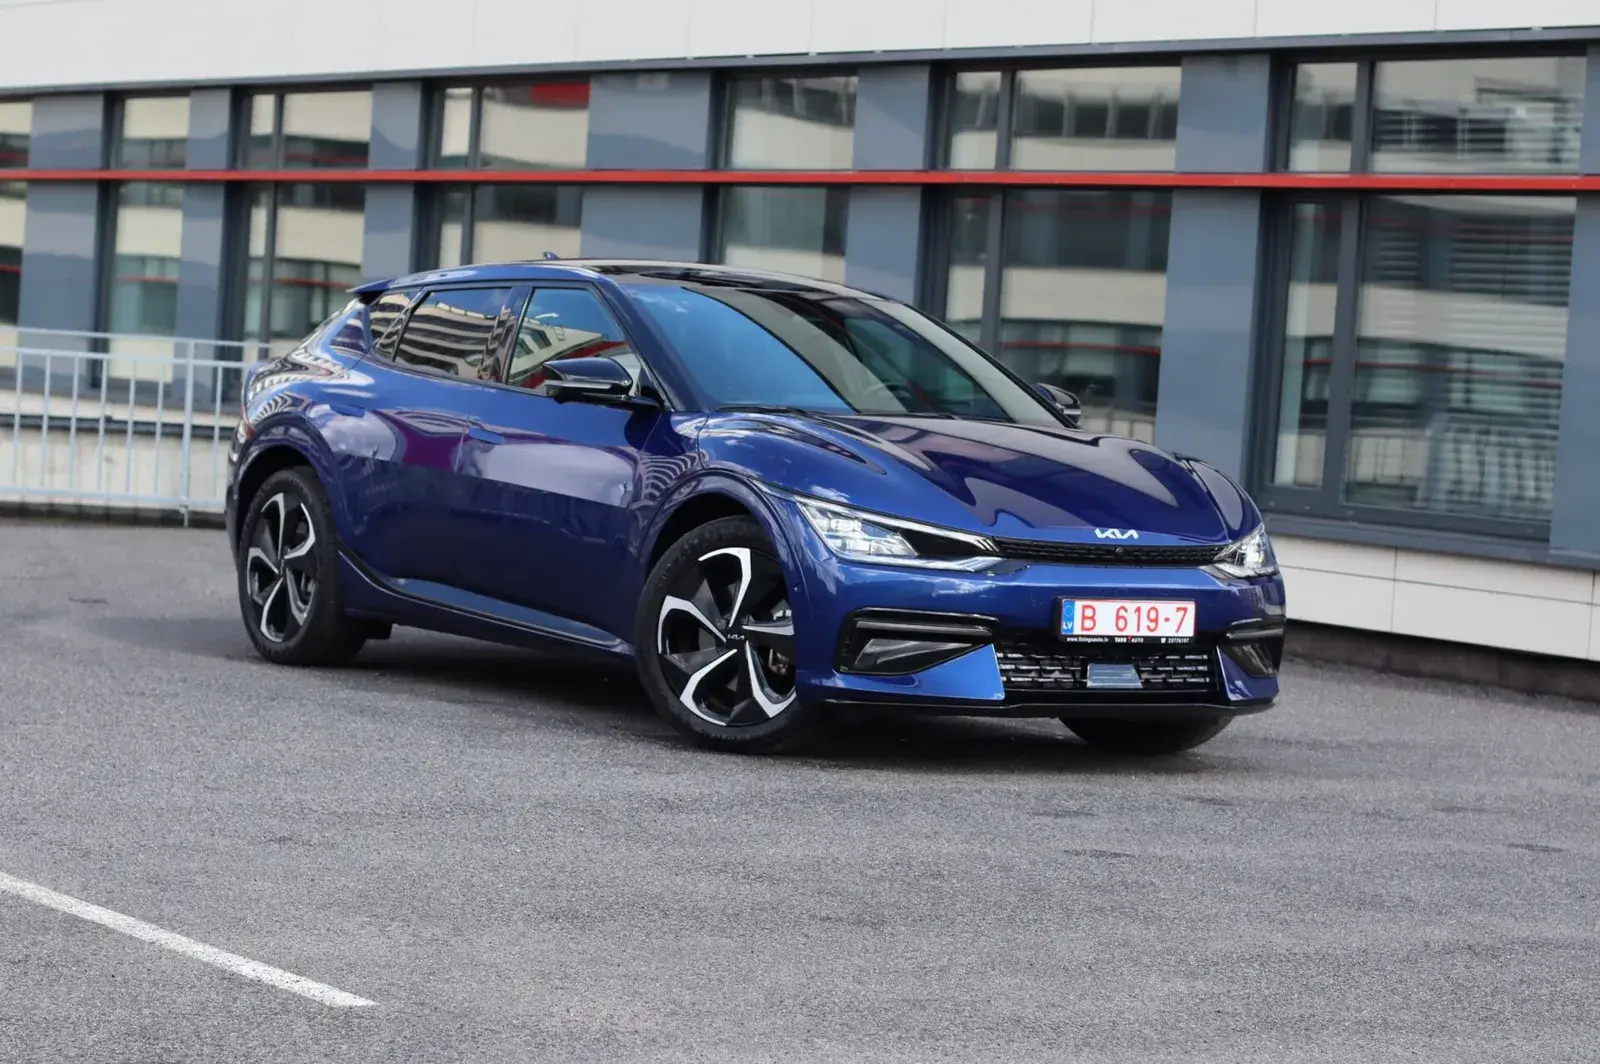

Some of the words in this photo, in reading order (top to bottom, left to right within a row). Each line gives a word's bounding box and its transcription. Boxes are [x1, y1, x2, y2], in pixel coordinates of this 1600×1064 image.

[1094, 527, 1139, 540] KIA
[1063, 620, 1074, 629] LV
[1080, 604, 1097, 632] B
[1115, 605, 1188, 633] 619-7
